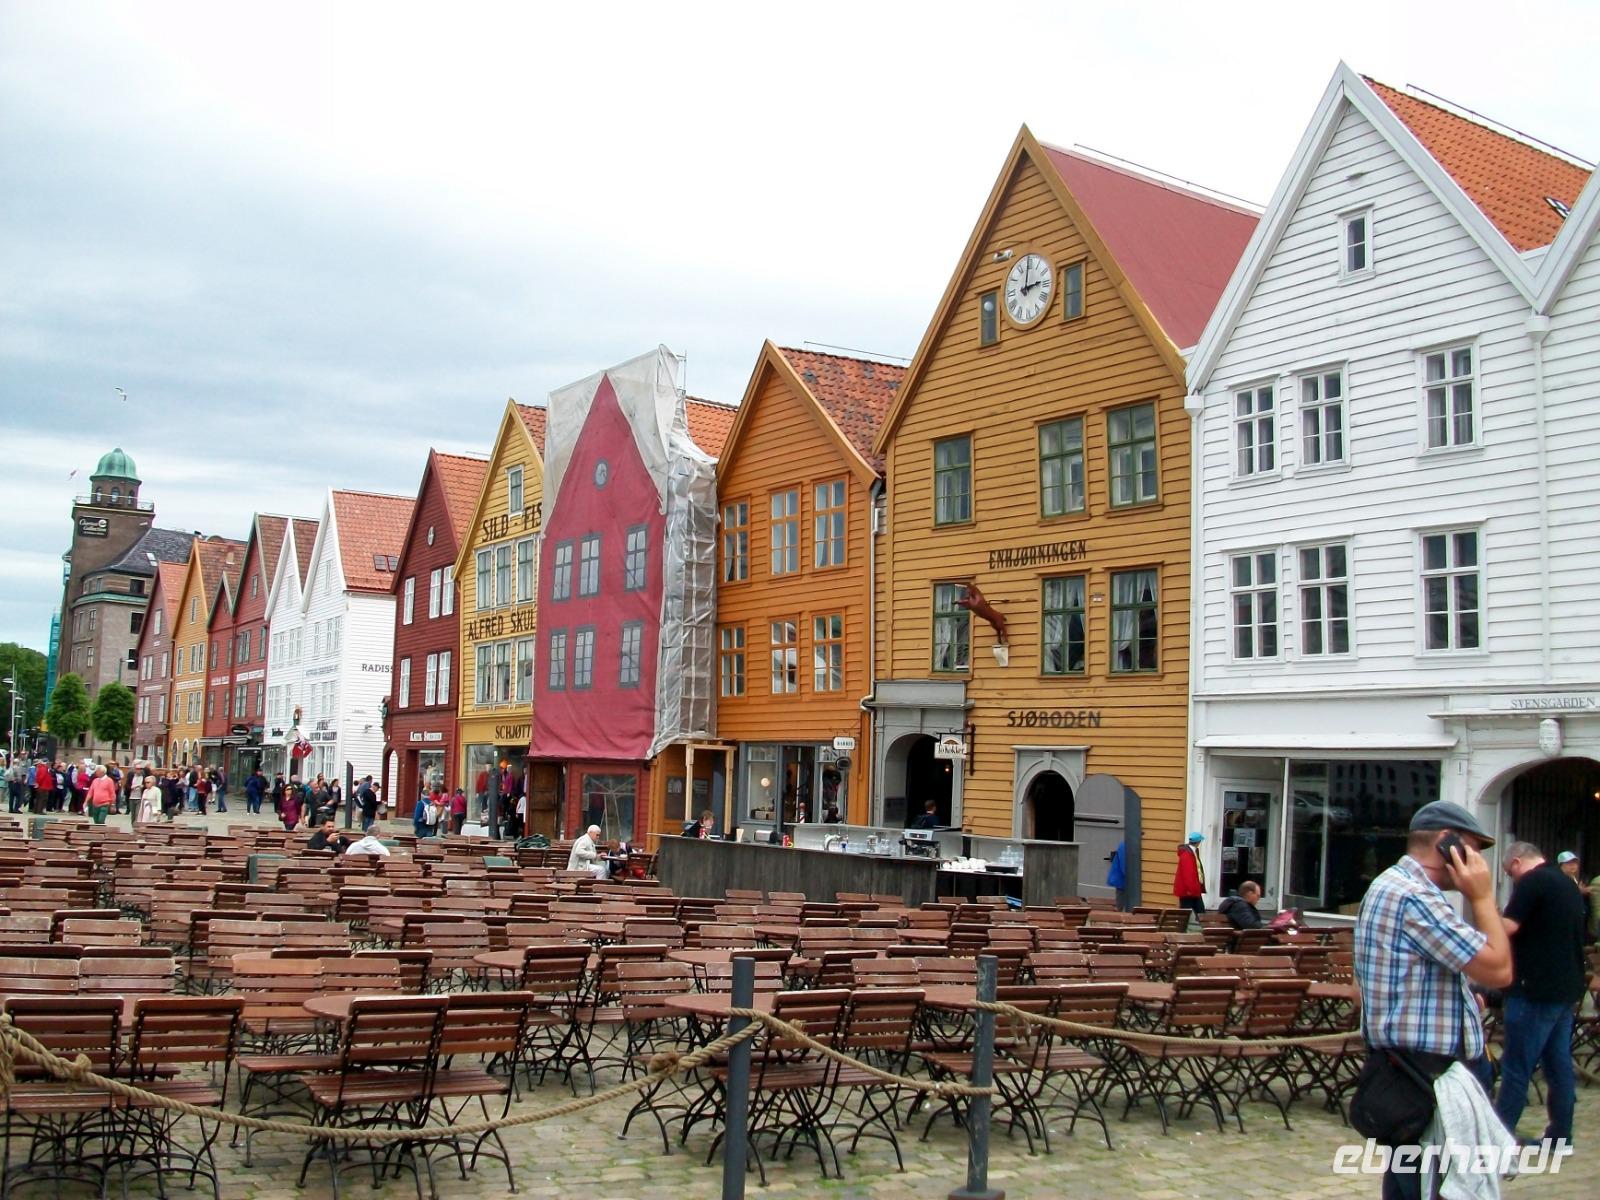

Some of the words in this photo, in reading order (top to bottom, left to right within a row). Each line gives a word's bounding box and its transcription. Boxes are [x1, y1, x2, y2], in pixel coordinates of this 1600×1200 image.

[482, 514, 509, 542] SILD
[988, 540, 1086, 569] ENHJØRNINGEN
[468, 615, 504, 640] ALFRED
[510, 609, 536, 633] SKUL
[495, 724, 532, 739] SCHJØTT
[1007, 710, 1101, 728] SJØBODEN
